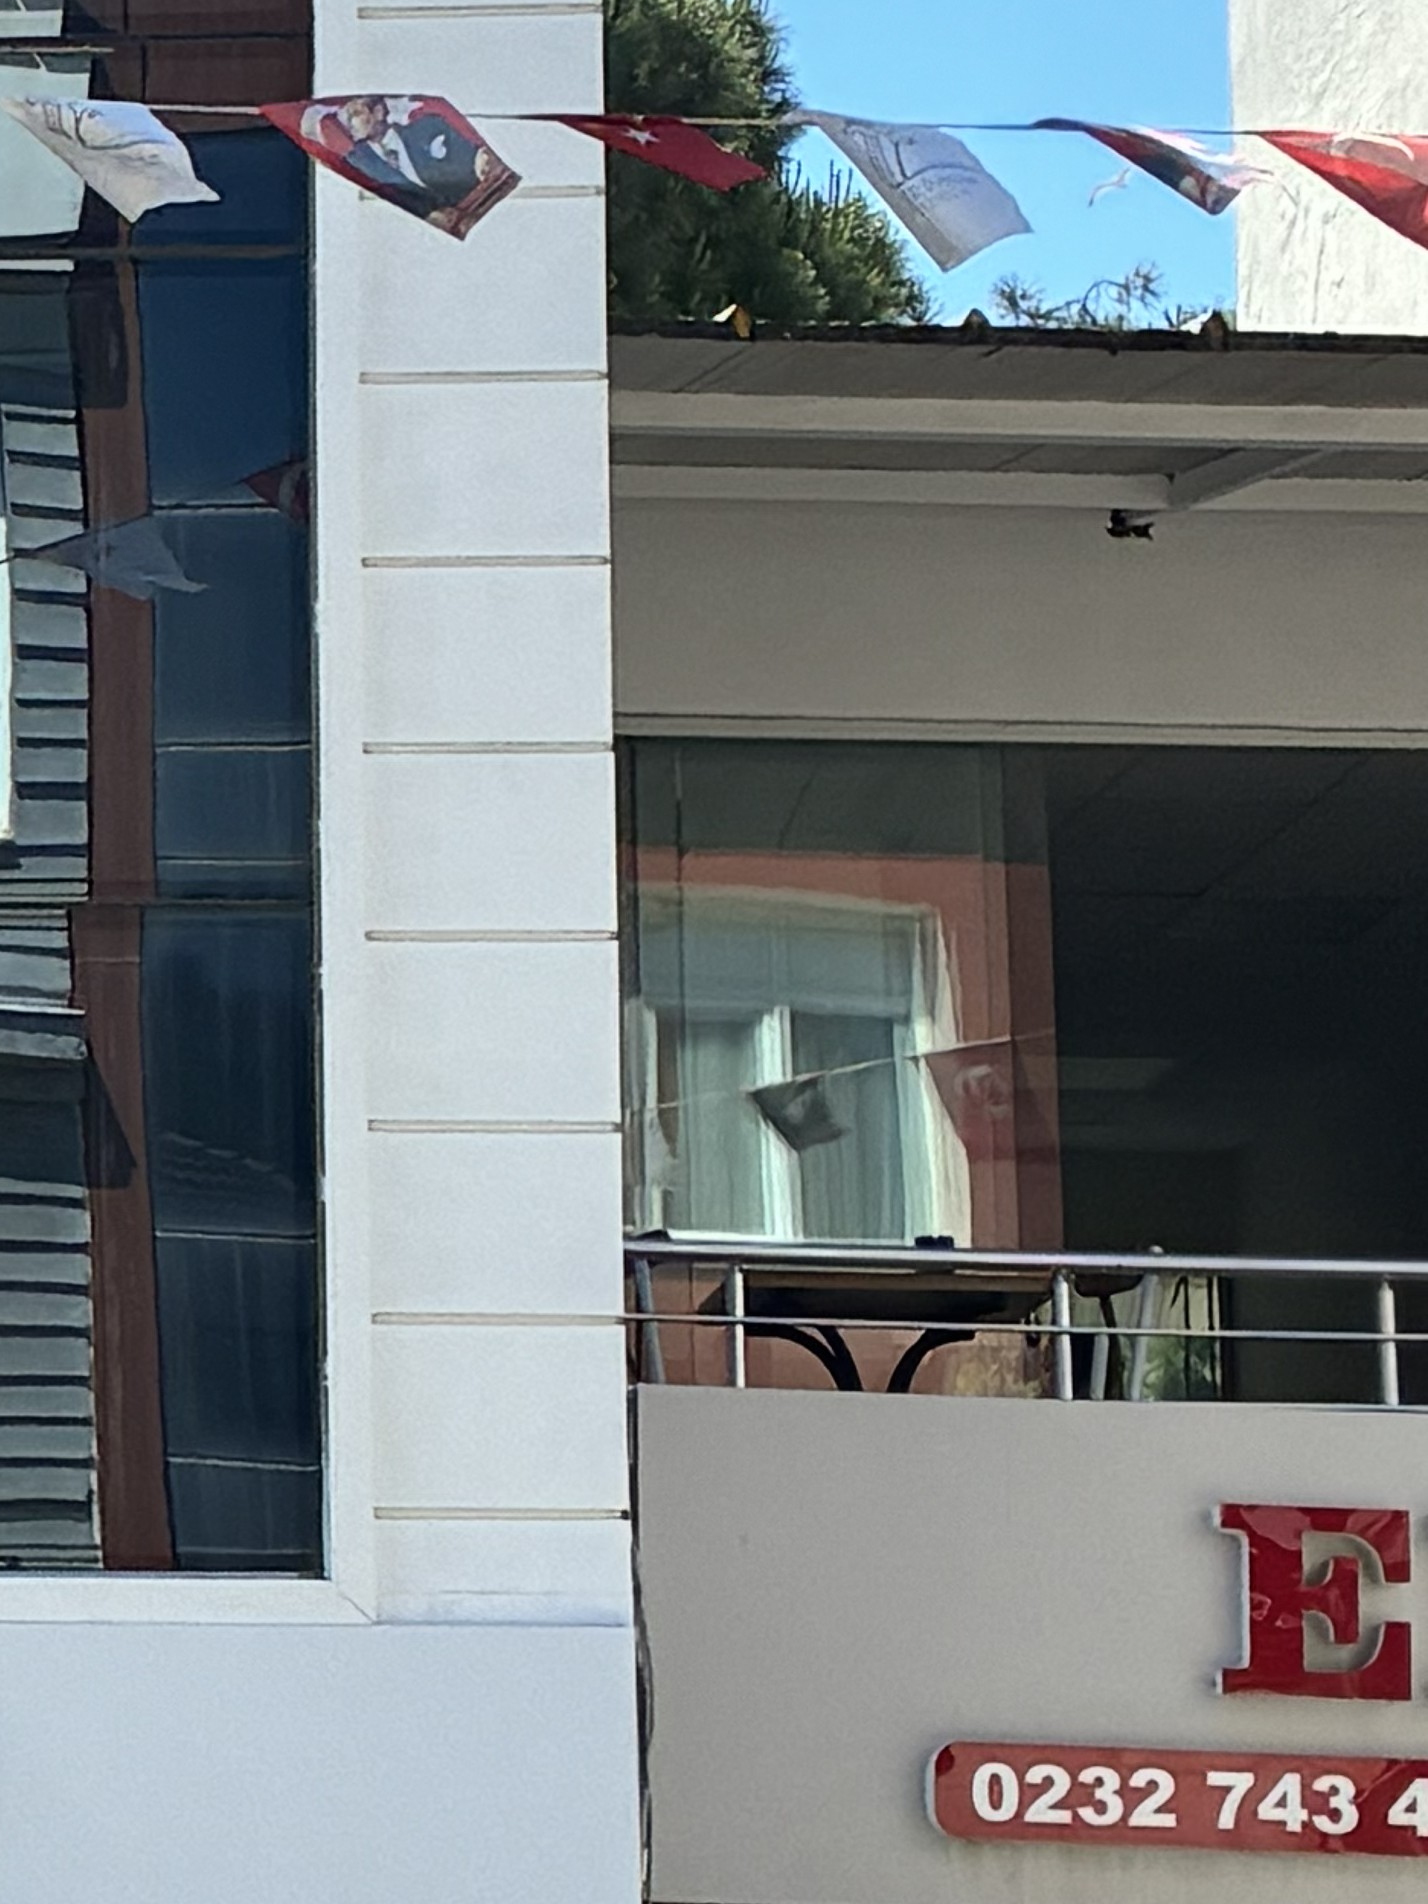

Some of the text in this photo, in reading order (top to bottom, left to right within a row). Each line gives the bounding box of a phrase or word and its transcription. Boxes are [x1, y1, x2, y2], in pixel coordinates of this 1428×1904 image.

[1210, 1502, 1428, 1701] E
[970, 1762, 1178, 1830] 0232
[1207, 1771, 1359, 1837] 743
